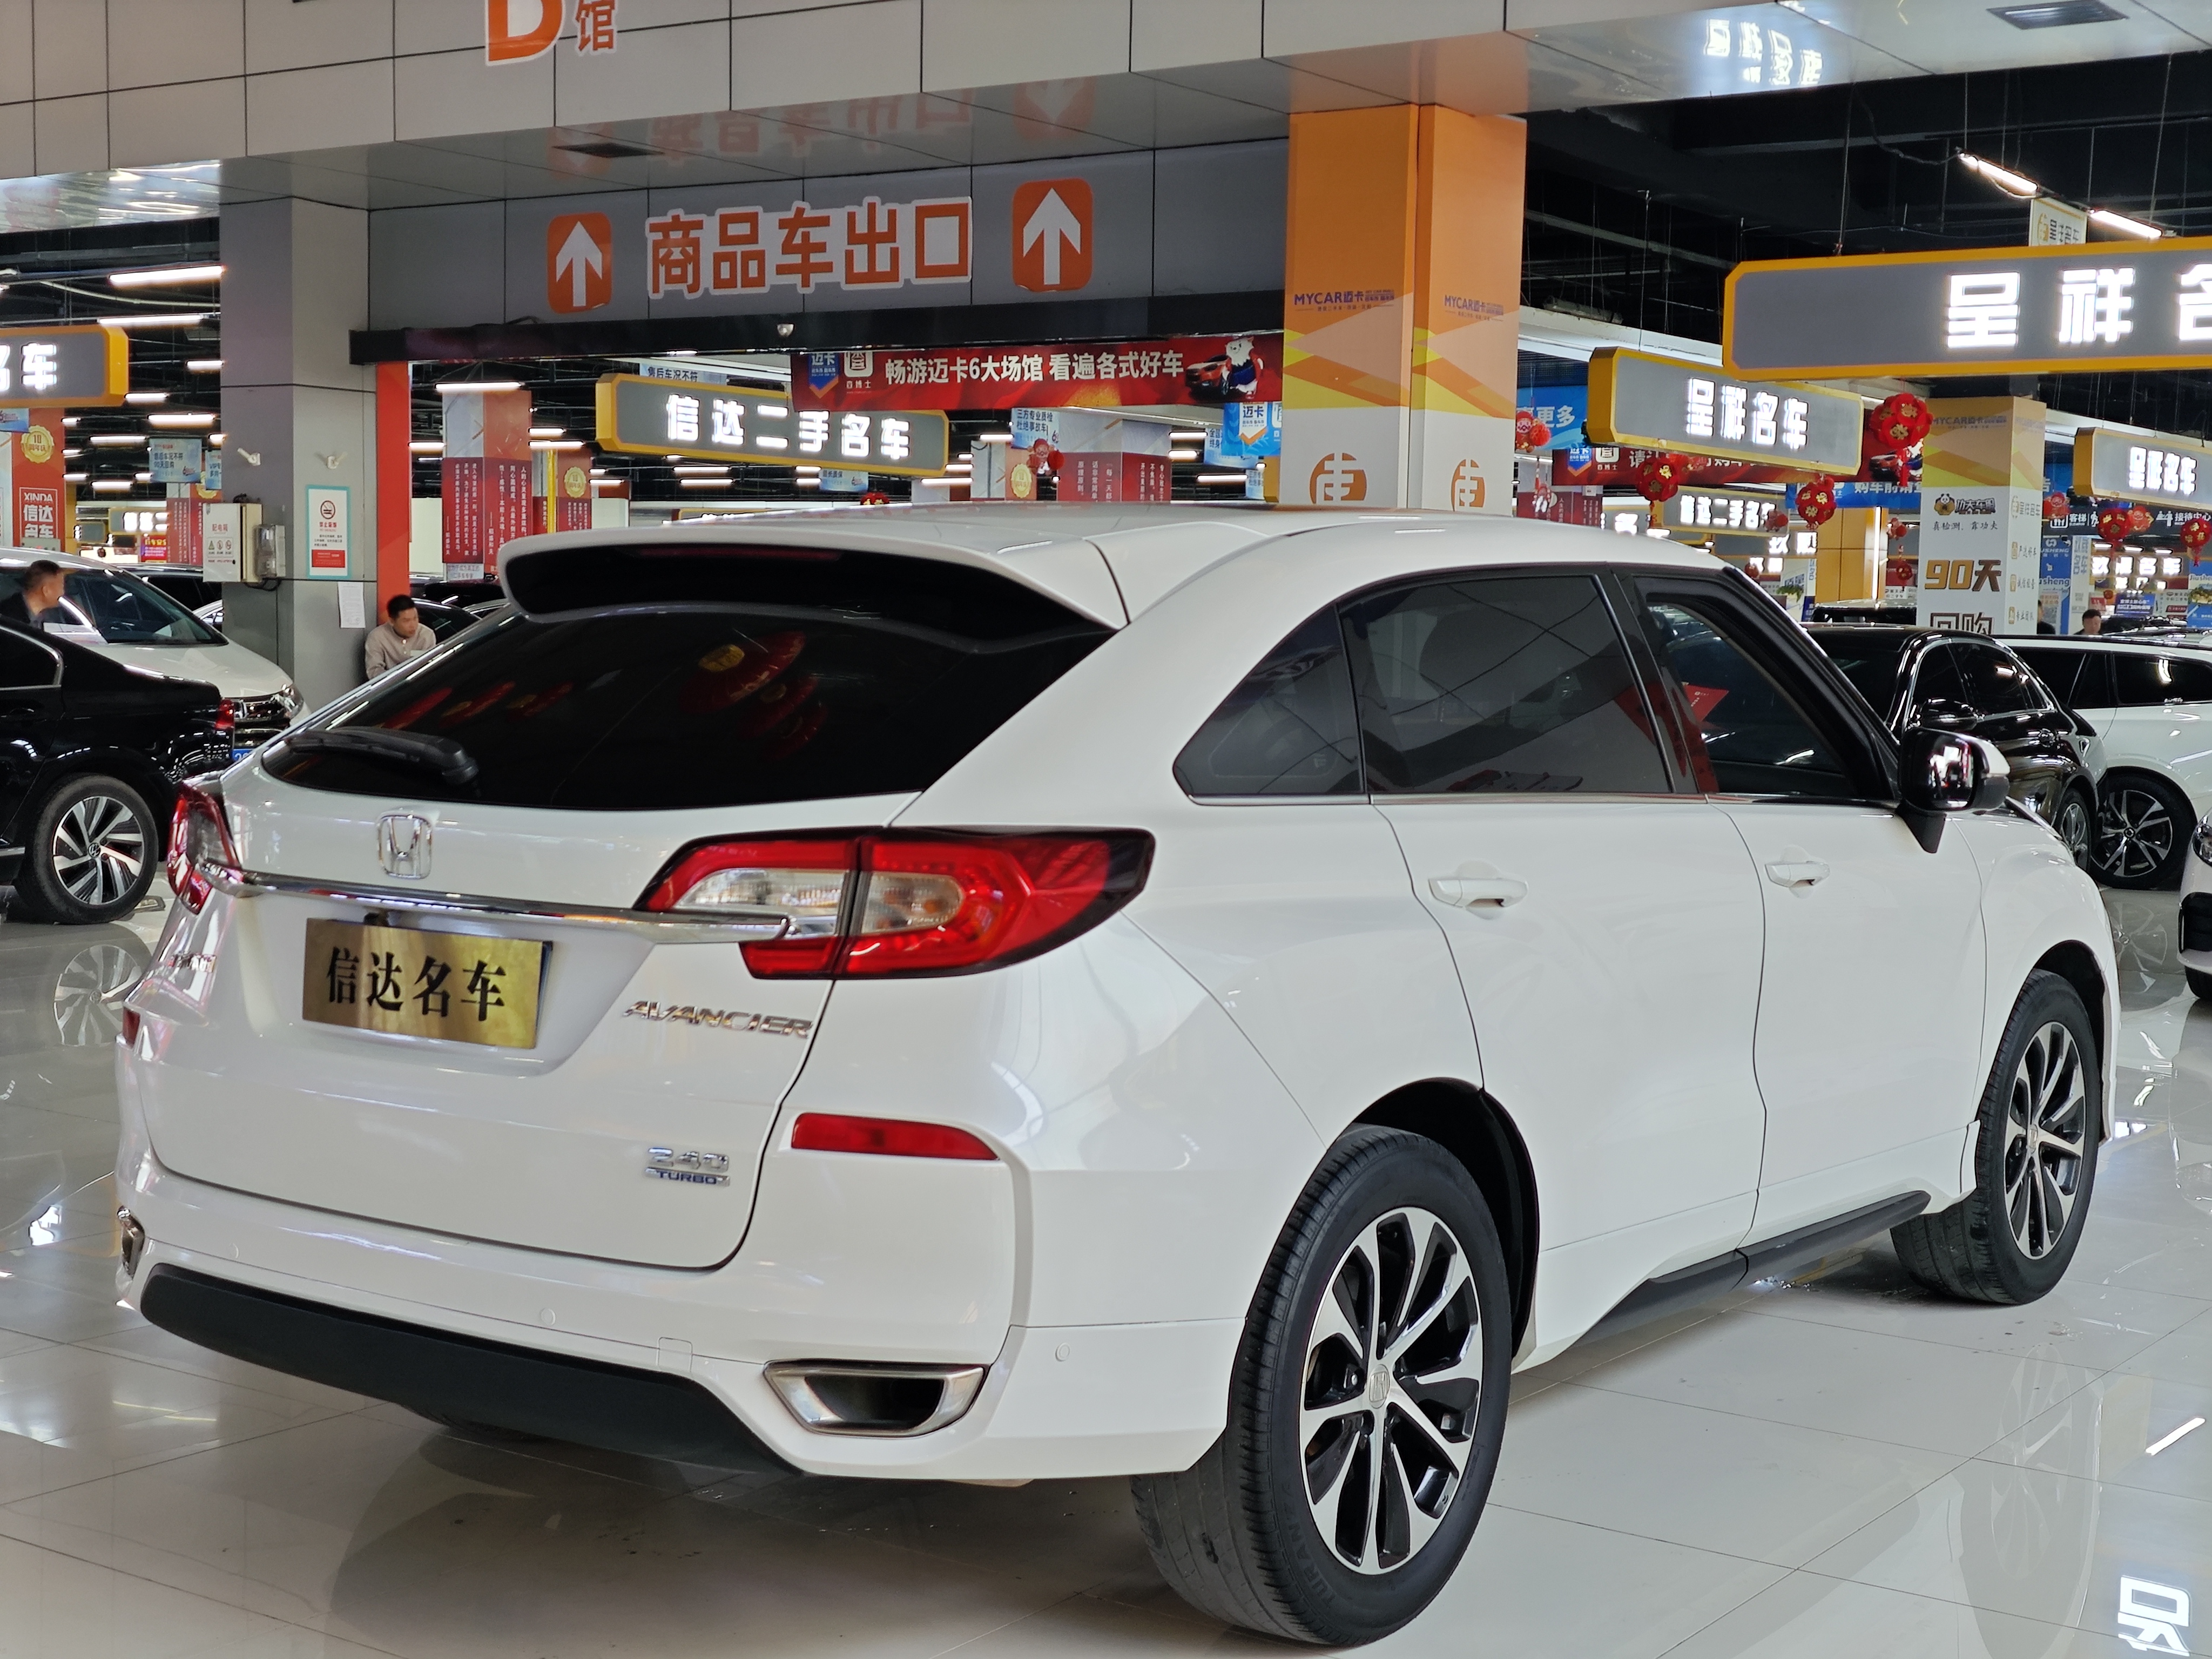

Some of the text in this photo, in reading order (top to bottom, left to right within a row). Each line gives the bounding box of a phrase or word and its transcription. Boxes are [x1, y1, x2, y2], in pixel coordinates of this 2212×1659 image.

[646, 197, 972, 298] 商品车出口
[886, 350, 1183, 385] 畅游迈卡6大场馆 看遍各式好车
[1243, 405, 1264, 418] 迈卡
[1687, 378, 1809, 449] 呈祥名车
[666, 393, 910, 460] 信达二手名车
[1209, 428, 1222, 439] 全国
[24, 492, 53, 502] XINDA
[23, 504, 53, 522] 信达
[2069, 513, 2086, 523] 客梯
[1924, 559, 2002, 592] 90天
[1930, 611, 1994, 635] 回购
[325, 947, 506, 1023] 信达名车
[623, 1000, 814, 1038] AVANCIER
[648, 1147, 730, 1172] 240
[657, 1170, 719, 1185] TURBO
